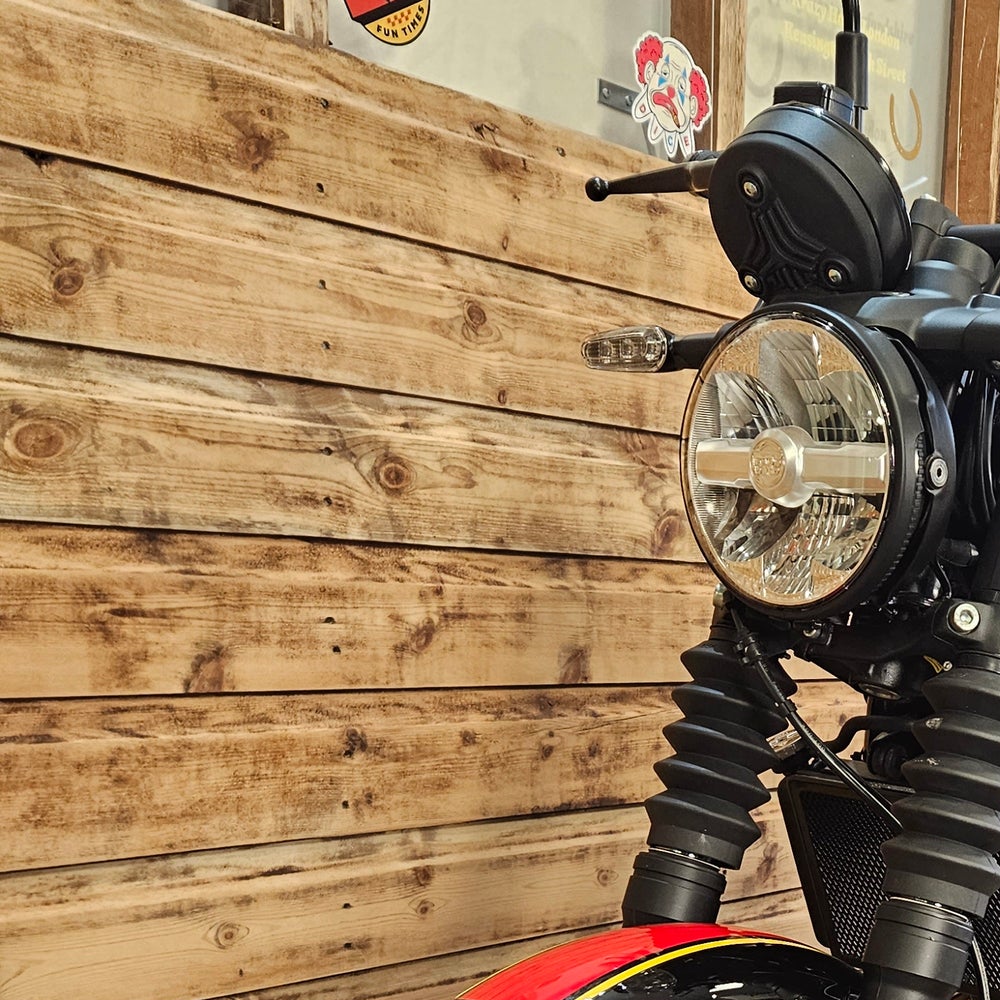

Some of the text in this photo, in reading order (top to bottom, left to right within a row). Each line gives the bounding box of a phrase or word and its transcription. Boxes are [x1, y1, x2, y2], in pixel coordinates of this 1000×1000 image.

[376, 4, 425, 38] FUN TIMES
[783, 20, 835, 61] Kensing
[639, 104, 690, 147] DICE
